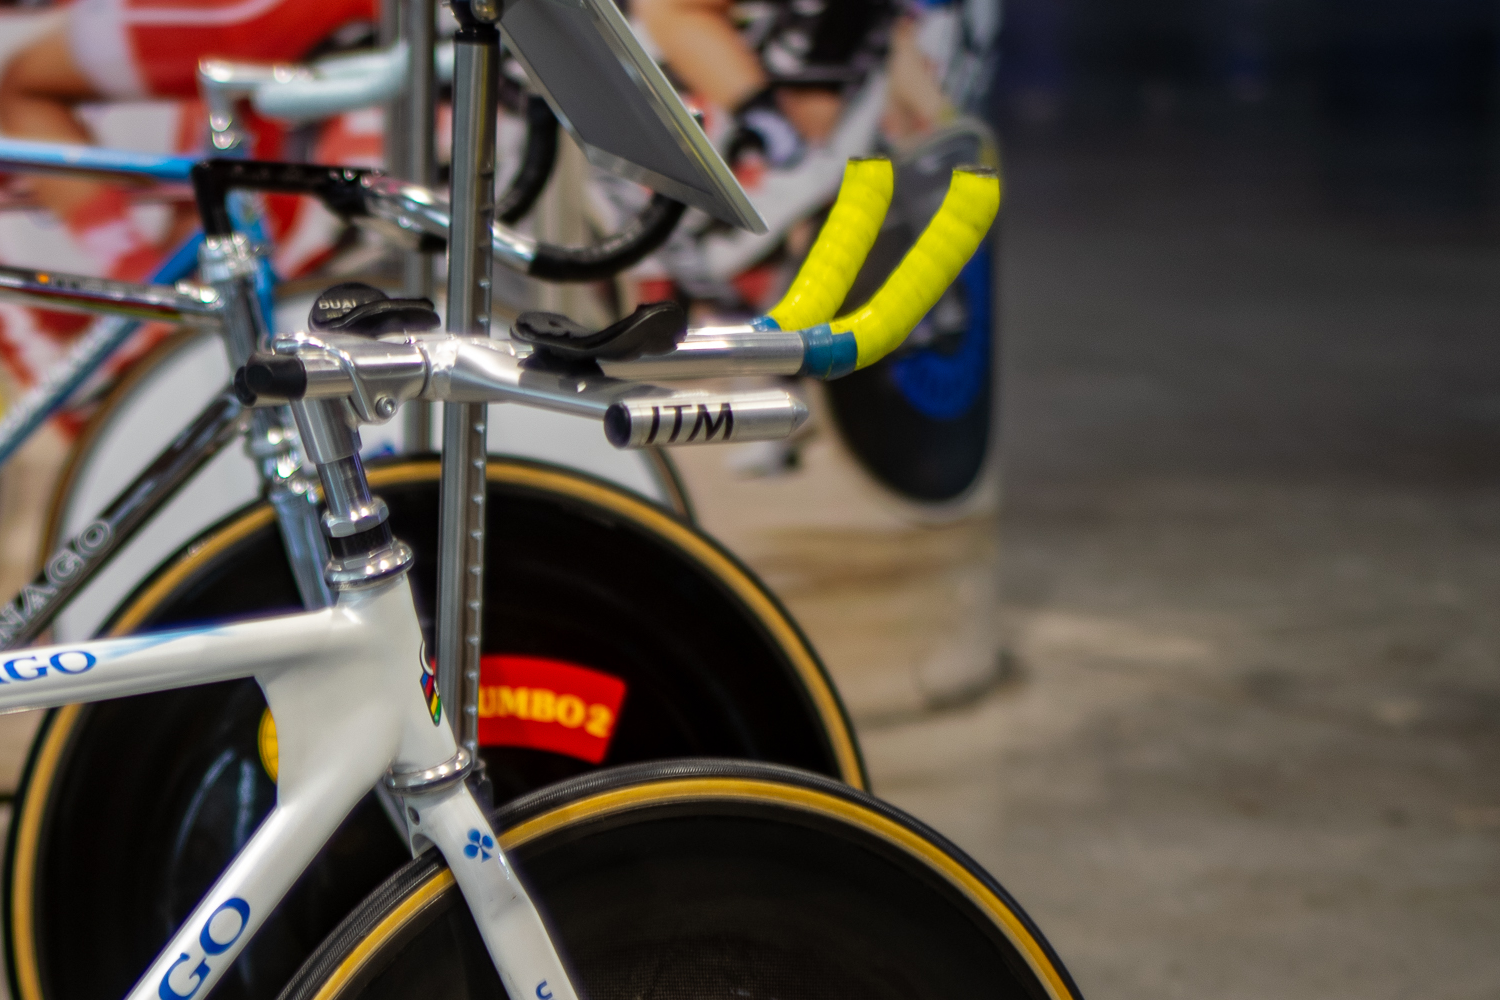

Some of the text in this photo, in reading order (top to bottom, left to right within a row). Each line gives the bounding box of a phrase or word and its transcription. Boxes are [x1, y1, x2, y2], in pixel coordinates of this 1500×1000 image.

[645, 403, 734, 445] ITM
[477, 684, 615, 739] UMBO 2
